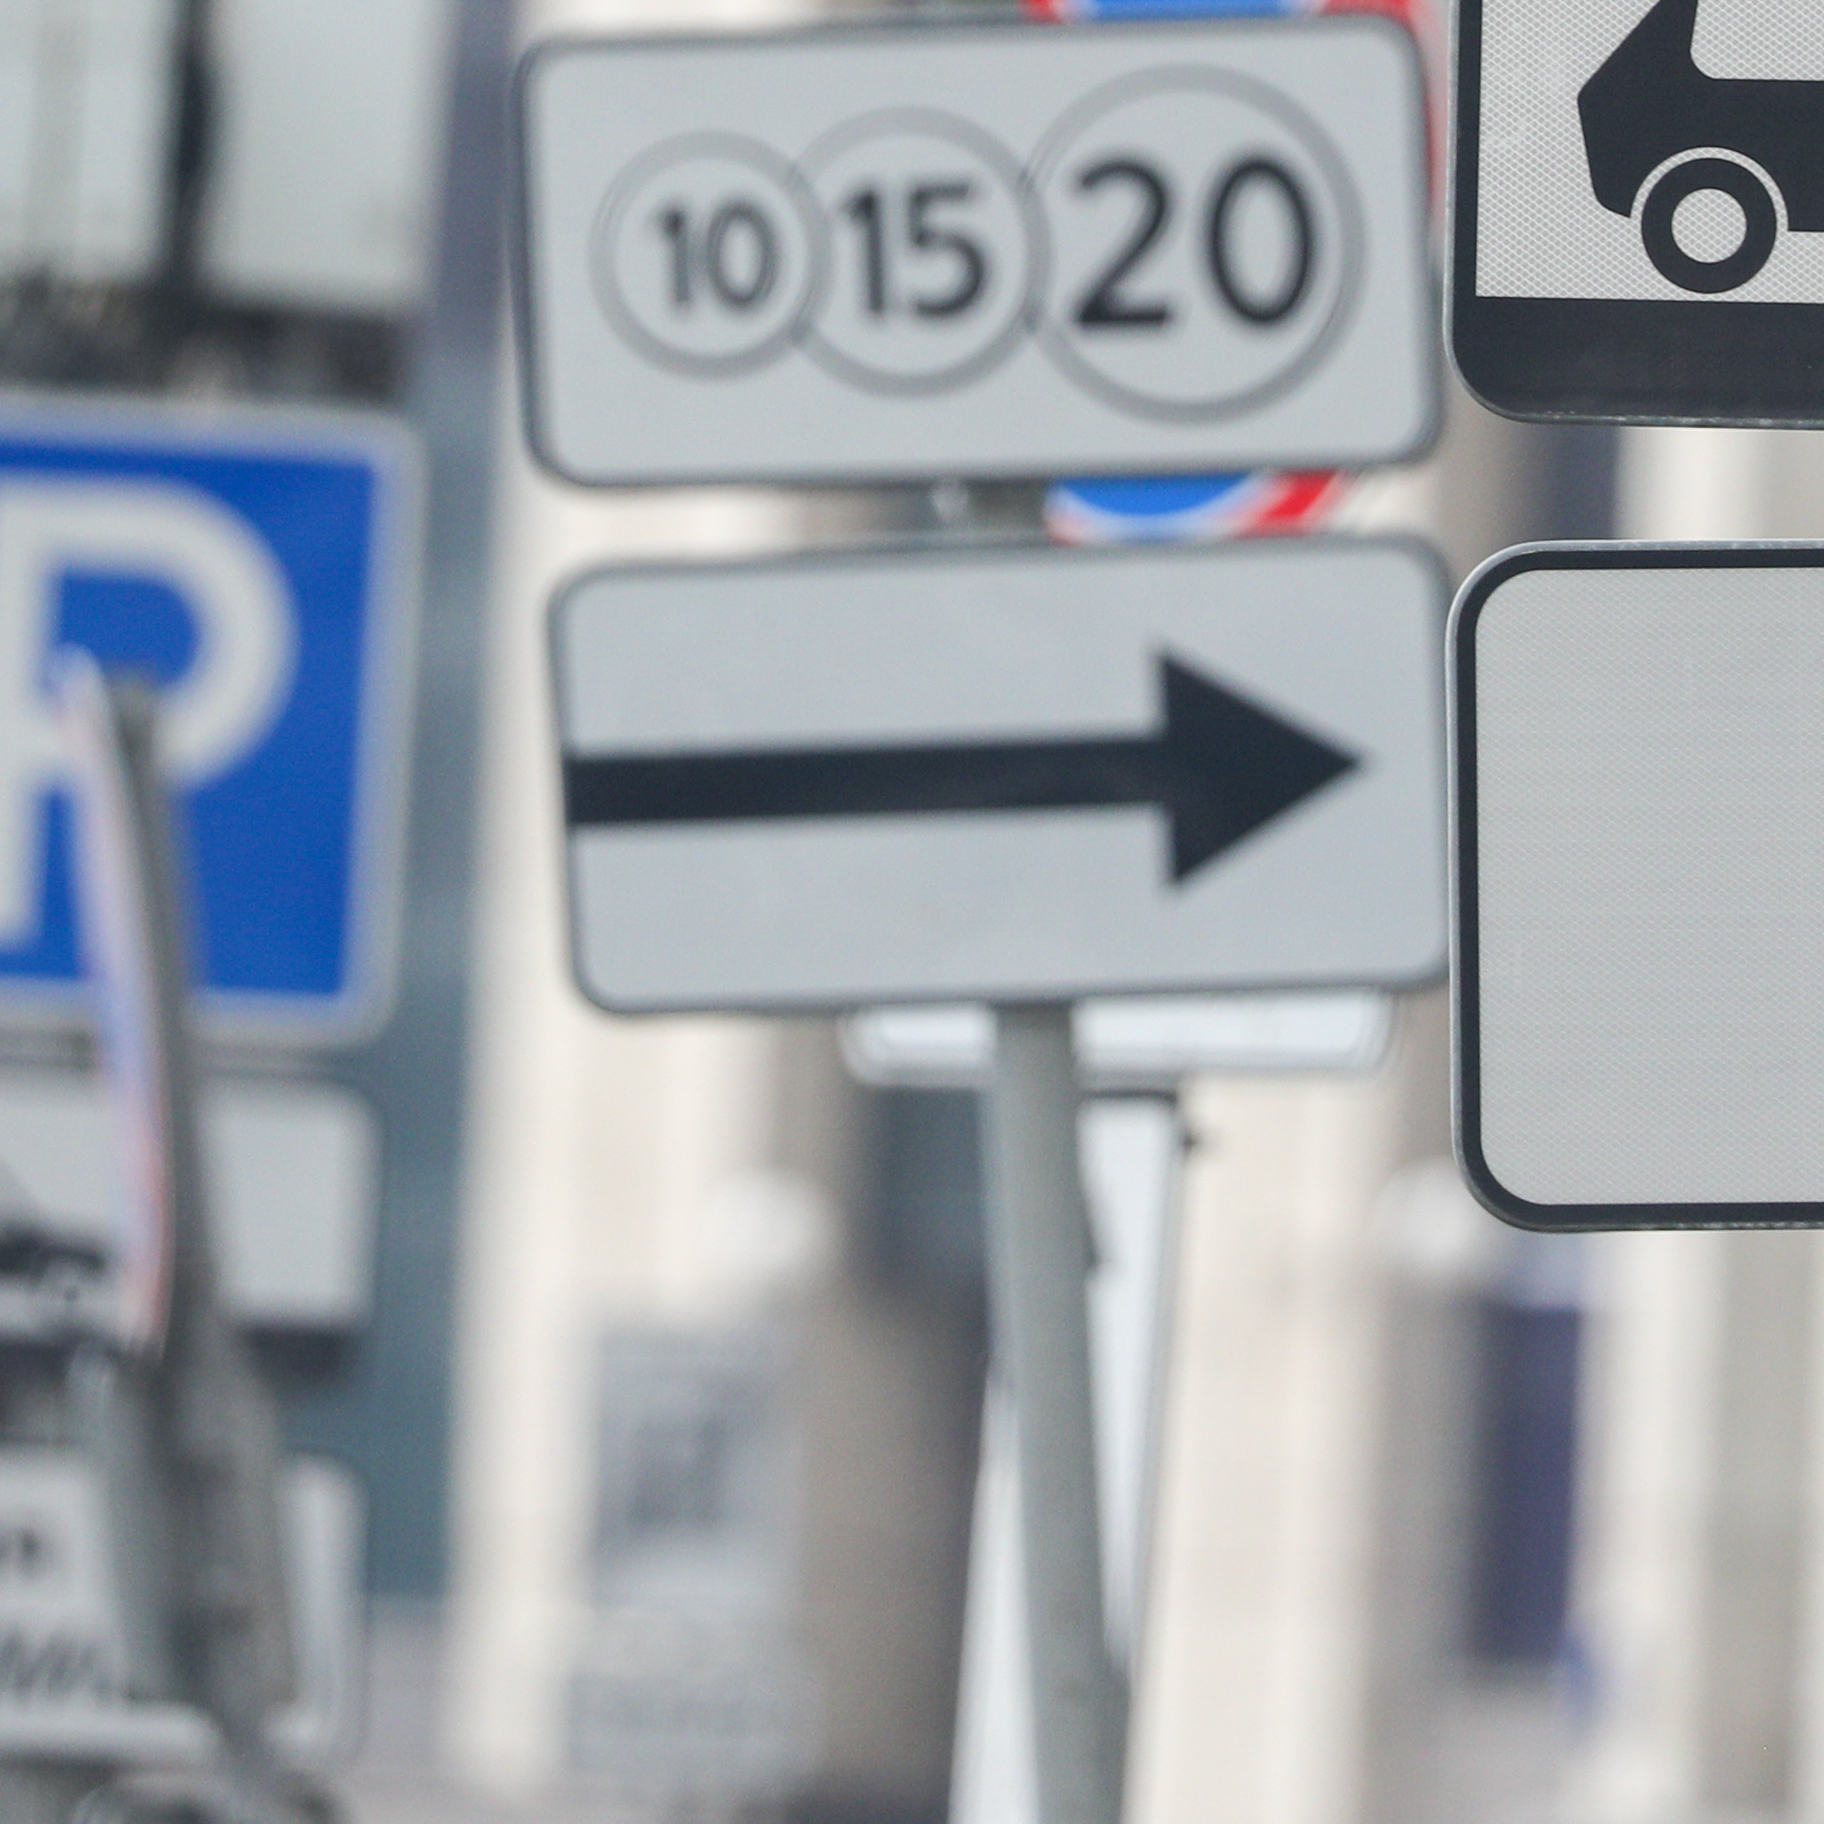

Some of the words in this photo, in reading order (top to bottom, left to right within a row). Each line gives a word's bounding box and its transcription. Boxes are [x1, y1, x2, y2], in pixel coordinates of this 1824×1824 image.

[652, 195, 780, 316] 10
[842, 174, 989, 321] 15
[1069, 152, 1319, 333] 20
